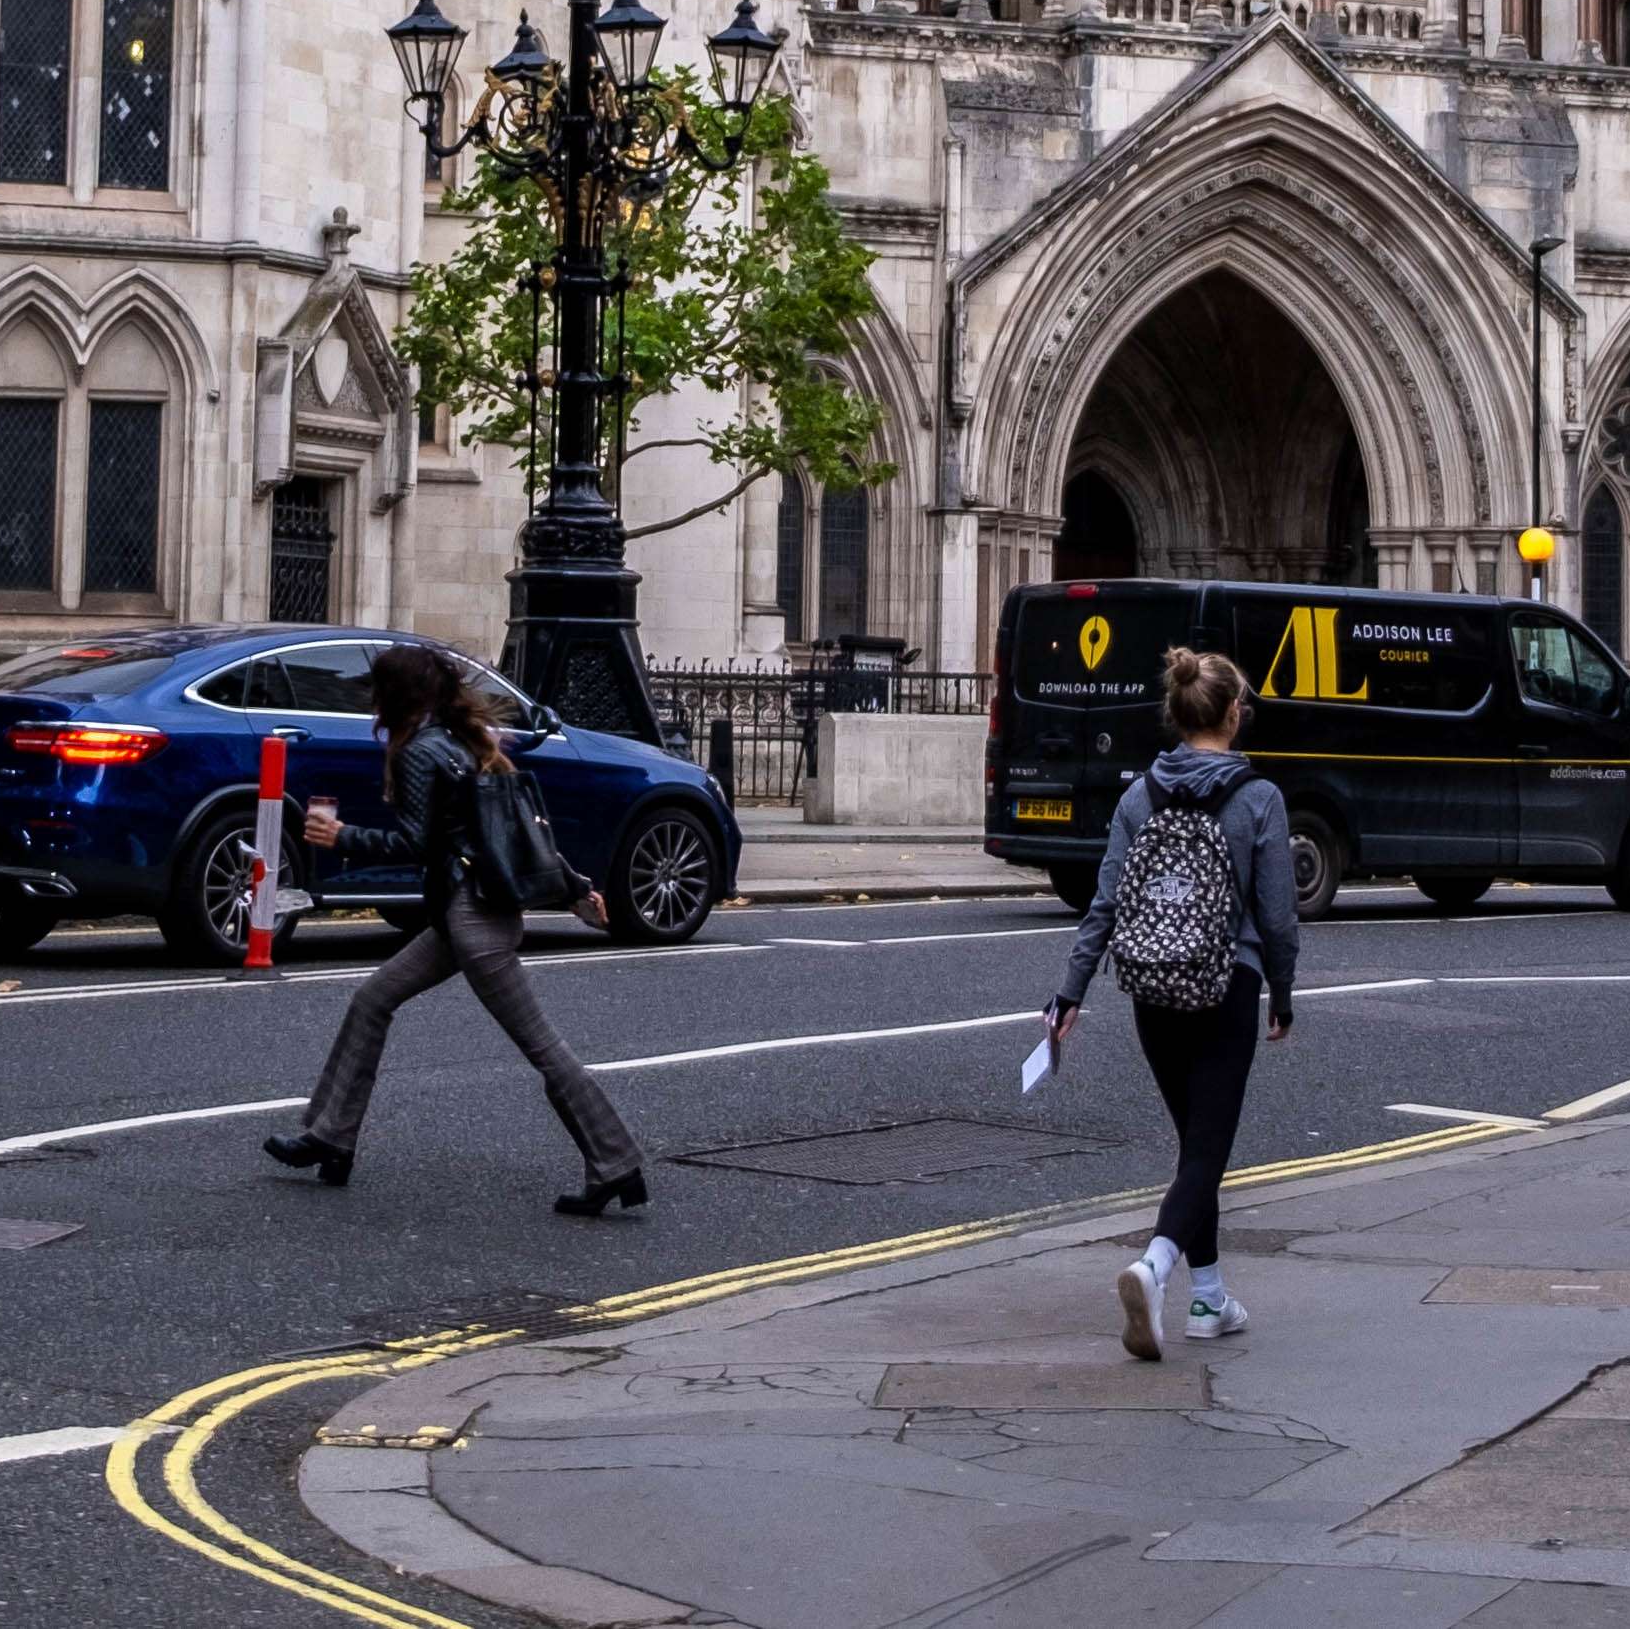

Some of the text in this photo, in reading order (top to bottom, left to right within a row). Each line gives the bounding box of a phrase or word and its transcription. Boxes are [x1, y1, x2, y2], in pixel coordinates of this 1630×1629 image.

[1352, 624, 1453, 642] ADDISON LEE
[1379, 649, 1429, 662] COURIER
[1039, 682, 1145, 695] DOWNLOAD THE APP
[1550, 765, 1626, 779] addisonlee.com
